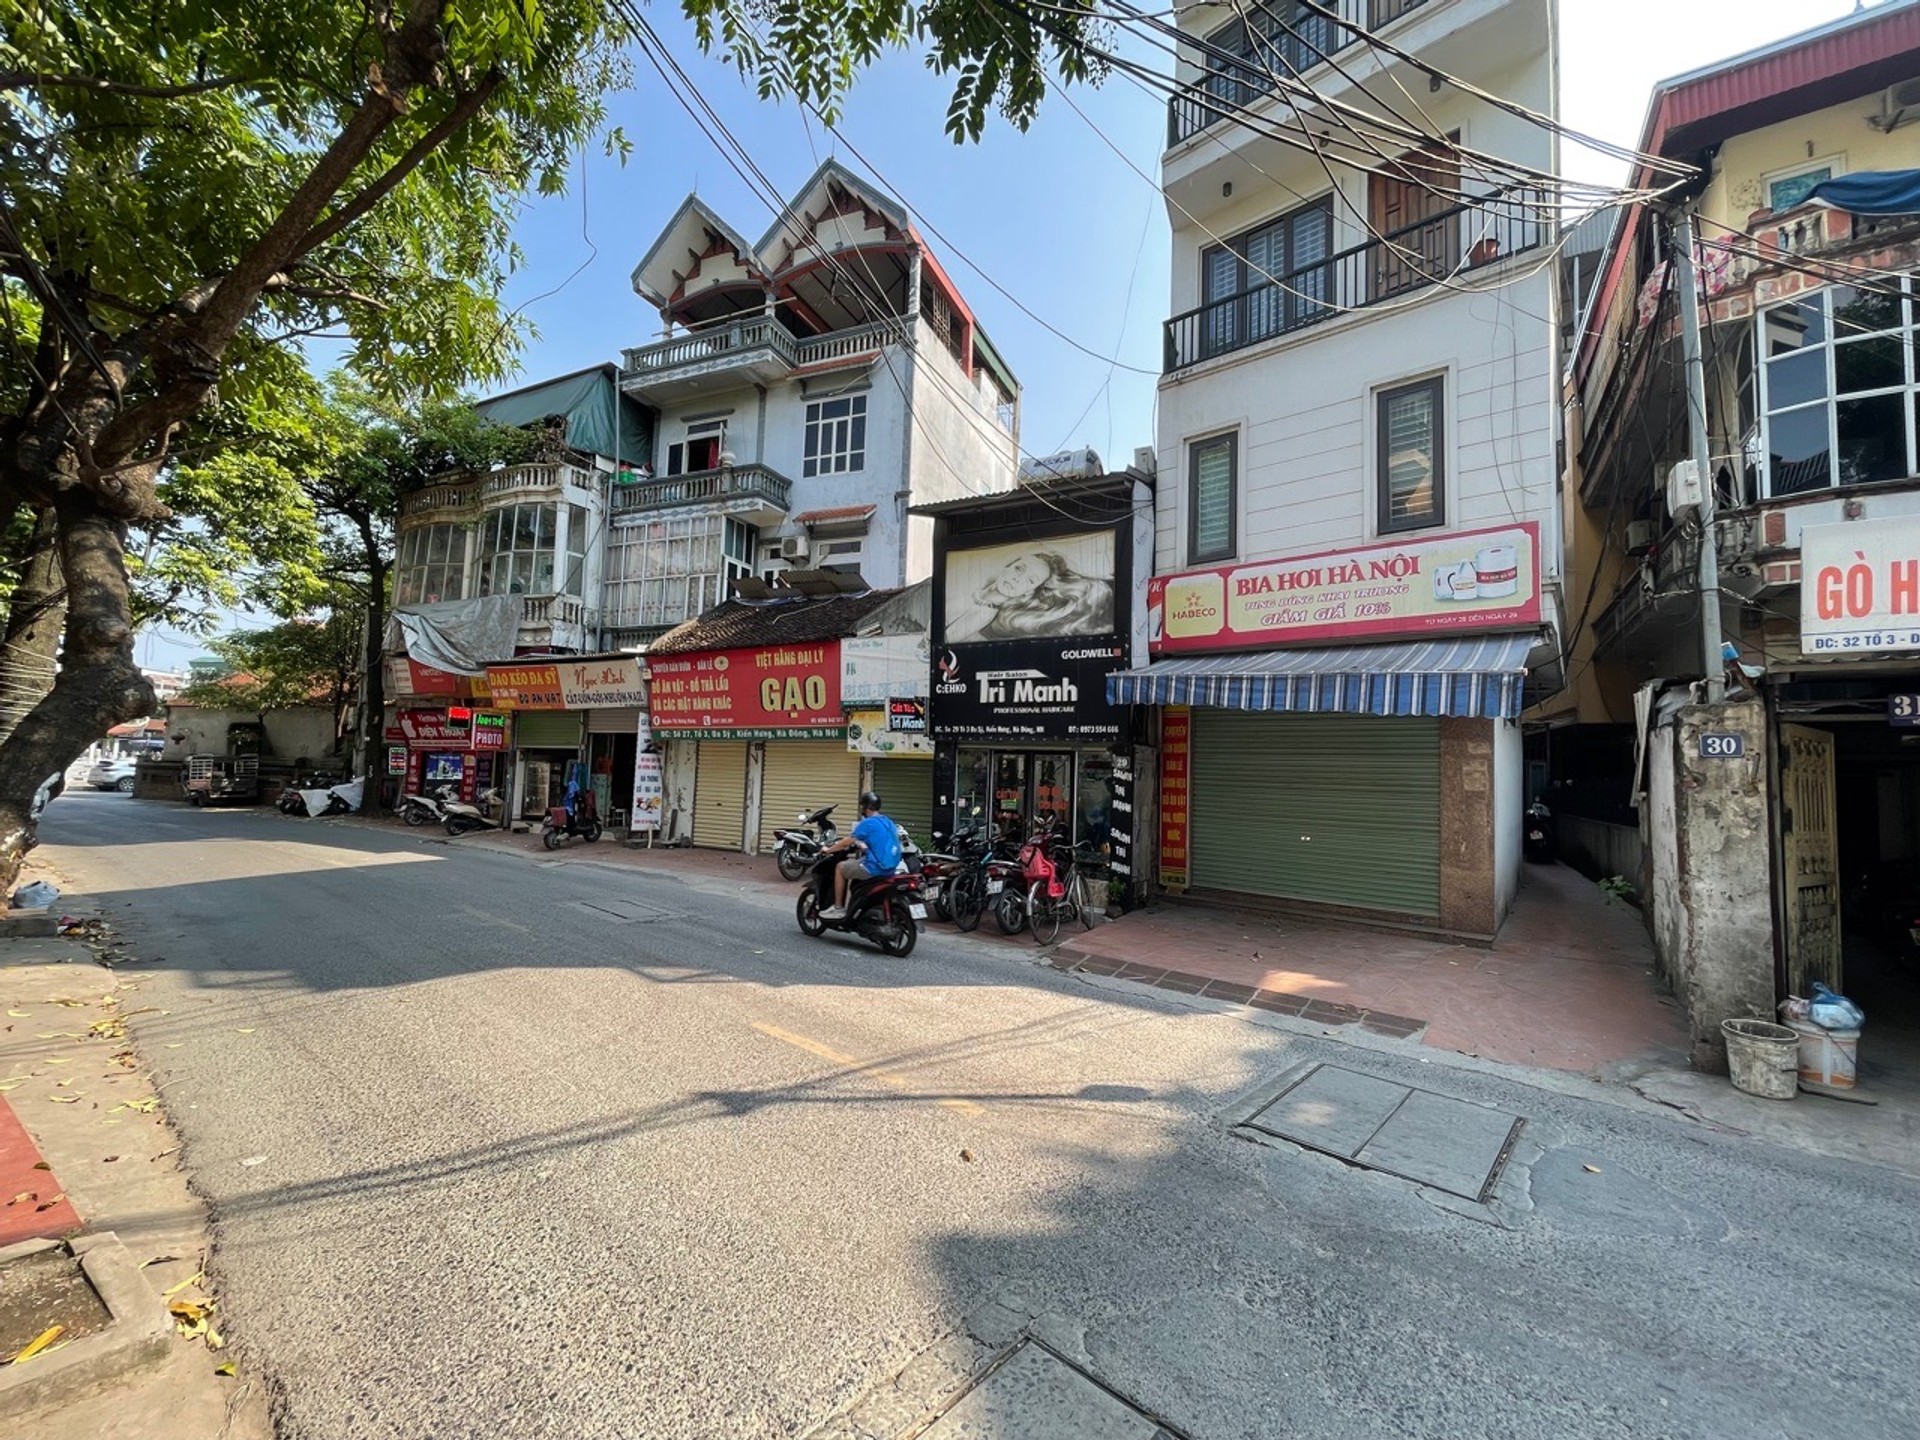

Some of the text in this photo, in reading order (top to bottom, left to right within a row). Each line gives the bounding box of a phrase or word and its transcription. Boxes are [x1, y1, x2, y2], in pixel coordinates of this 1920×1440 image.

[1236, 553, 1421, 597] BIA HƠI HÀ NỘI
[1817, 551, 1873, 620] GÒ
[1172, 606, 1217, 620] HABECO
[1354, 602, 1392, 617] 10%
[1815, 638, 1839, 649] ĐC:
[1843, 636, 1860, 648] 32
[1864, 630, 1882, 647] TỔ
[1886, 634, 1896, 646] 3
[1061, 648, 1114, 660] GOLDWELL
[760, 674, 826, 718] GẠO
[935, 683, 967, 694] C:EHKO
[1013, 677, 1078, 703] Manh
[476, 731, 503, 745] PHOTO
[1706, 736, 1737, 755] 30
